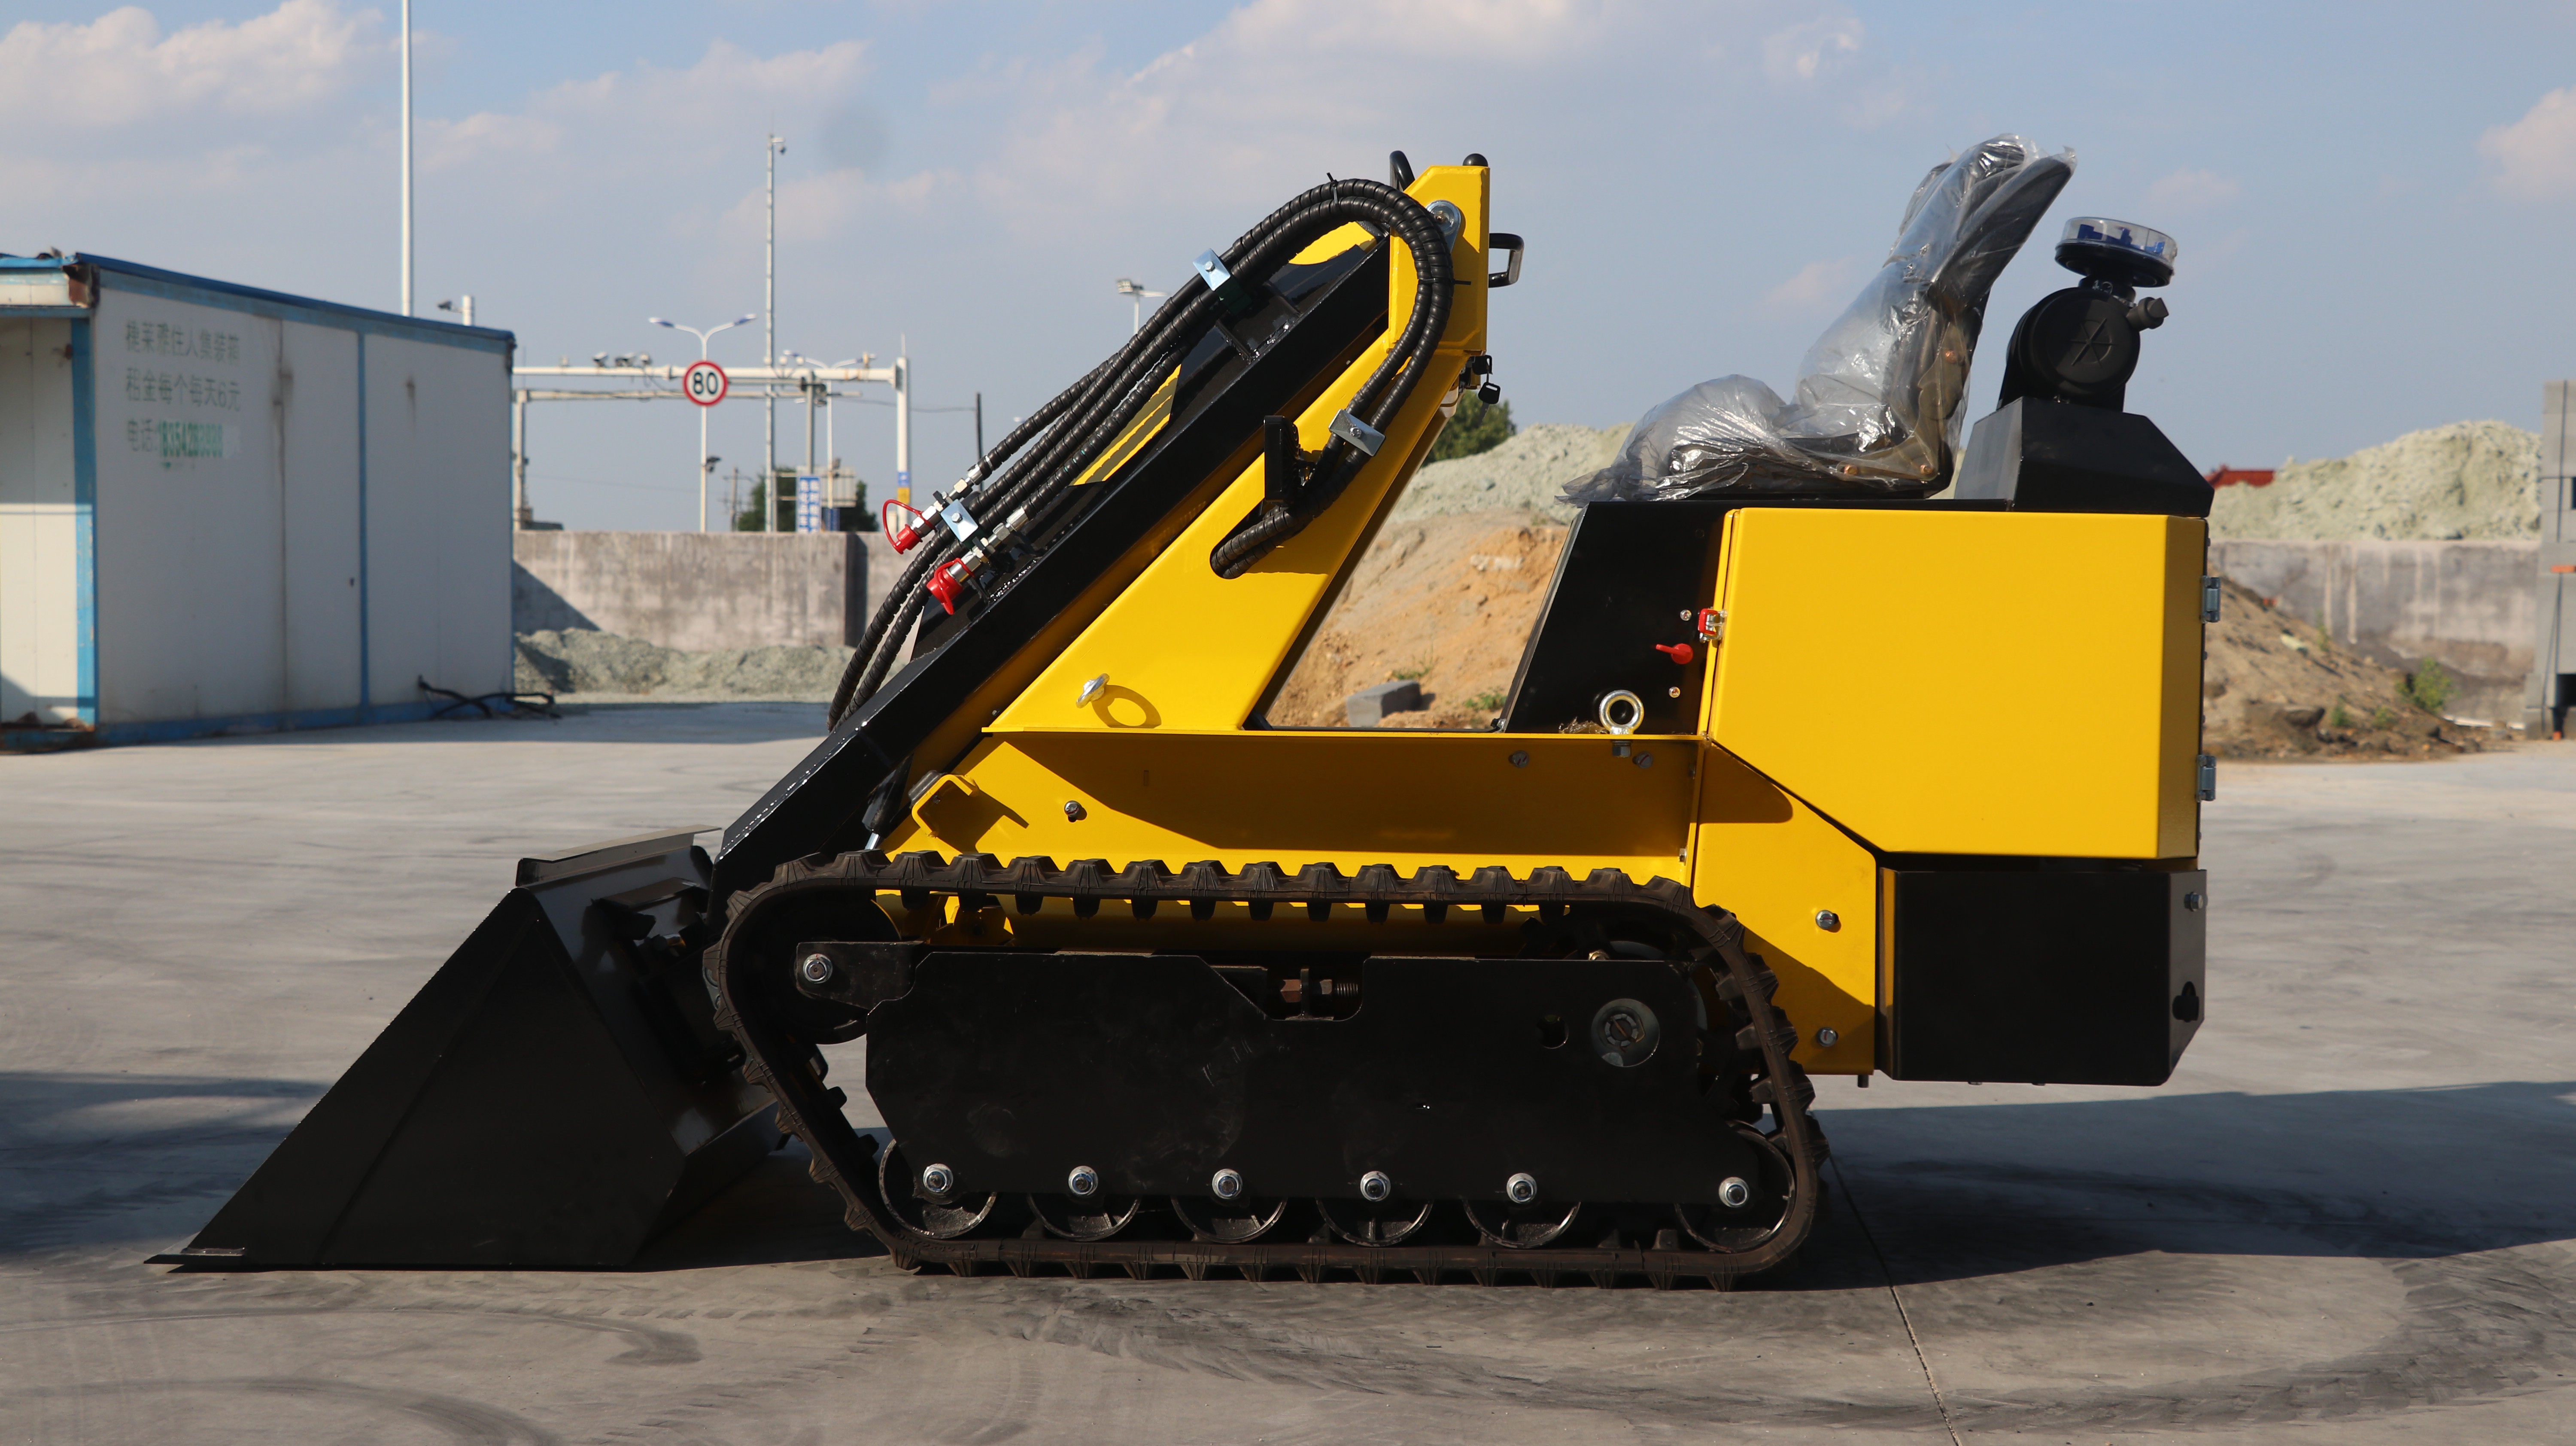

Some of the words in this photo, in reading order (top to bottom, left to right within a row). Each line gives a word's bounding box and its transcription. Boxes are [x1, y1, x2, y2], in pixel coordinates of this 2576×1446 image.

[126, 367, 240, 411] 租金每个每天6元
[694, 372, 717, 395] 80
